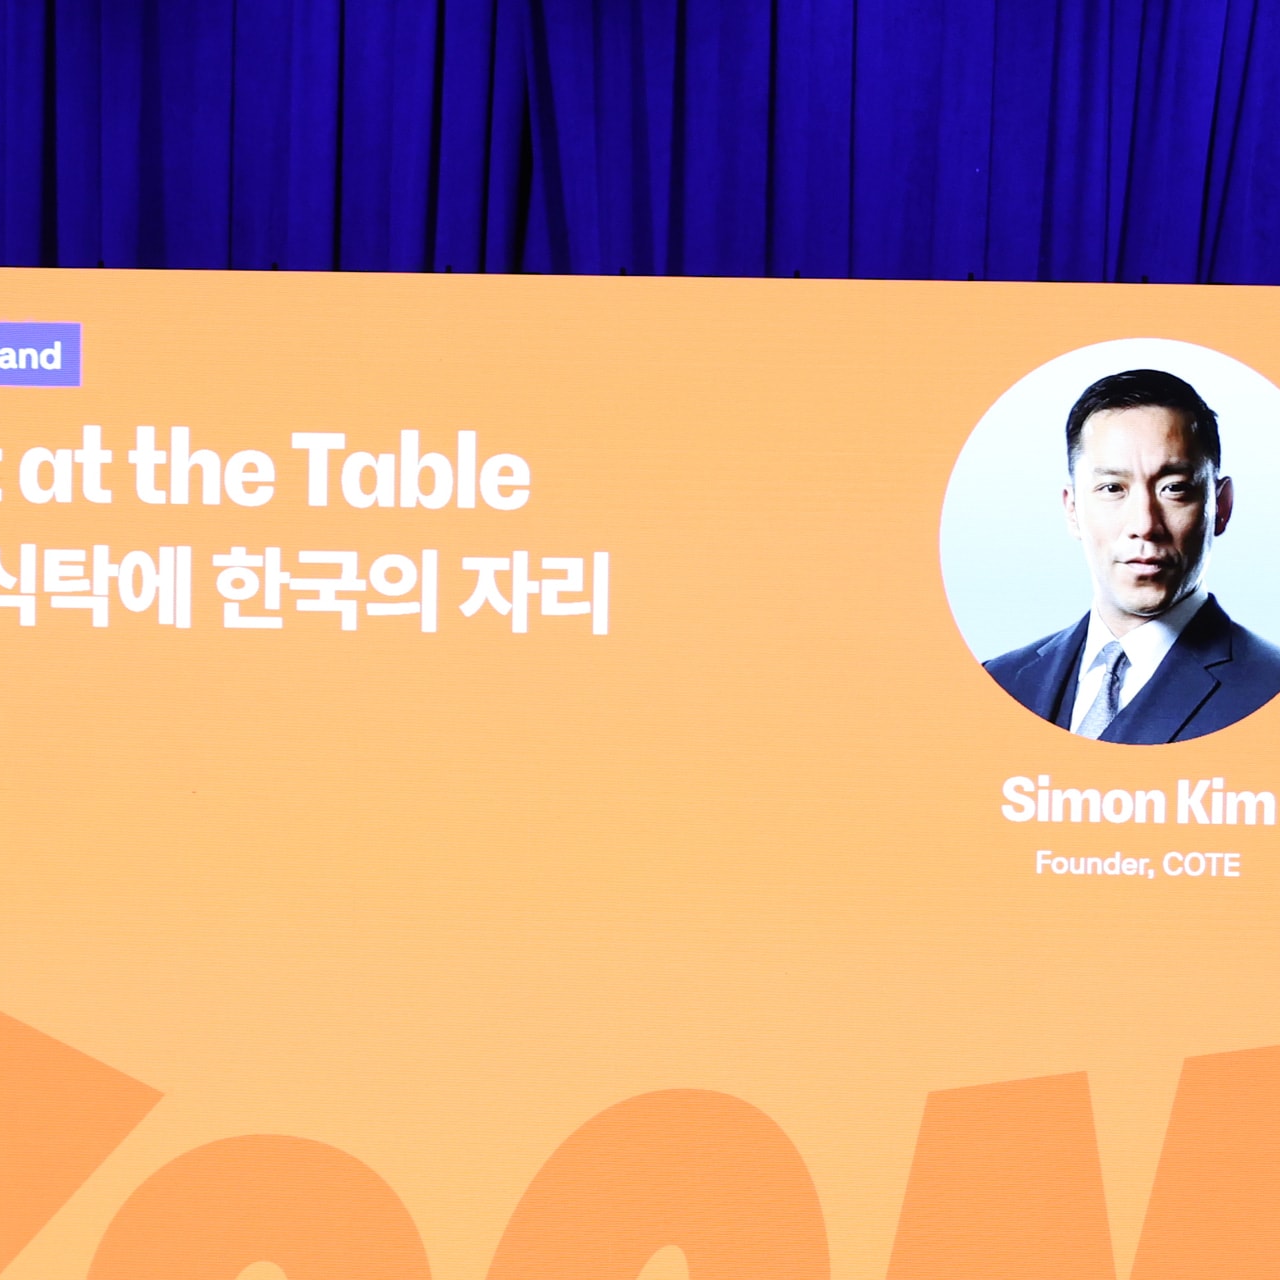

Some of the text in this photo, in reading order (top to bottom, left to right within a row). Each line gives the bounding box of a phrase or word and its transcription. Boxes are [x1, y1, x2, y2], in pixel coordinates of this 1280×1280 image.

[19, 424, 113, 504] at
[127, 425, 276, 507] the
[291, 429, 531, 511] Table
[212, 546, 438, 633] 한국의
[459, 550, 610, 636] 자리
[1001, 774, 1276, 826] Simon Kim
[1036, 850, 1241, 879] Founder, COTE
